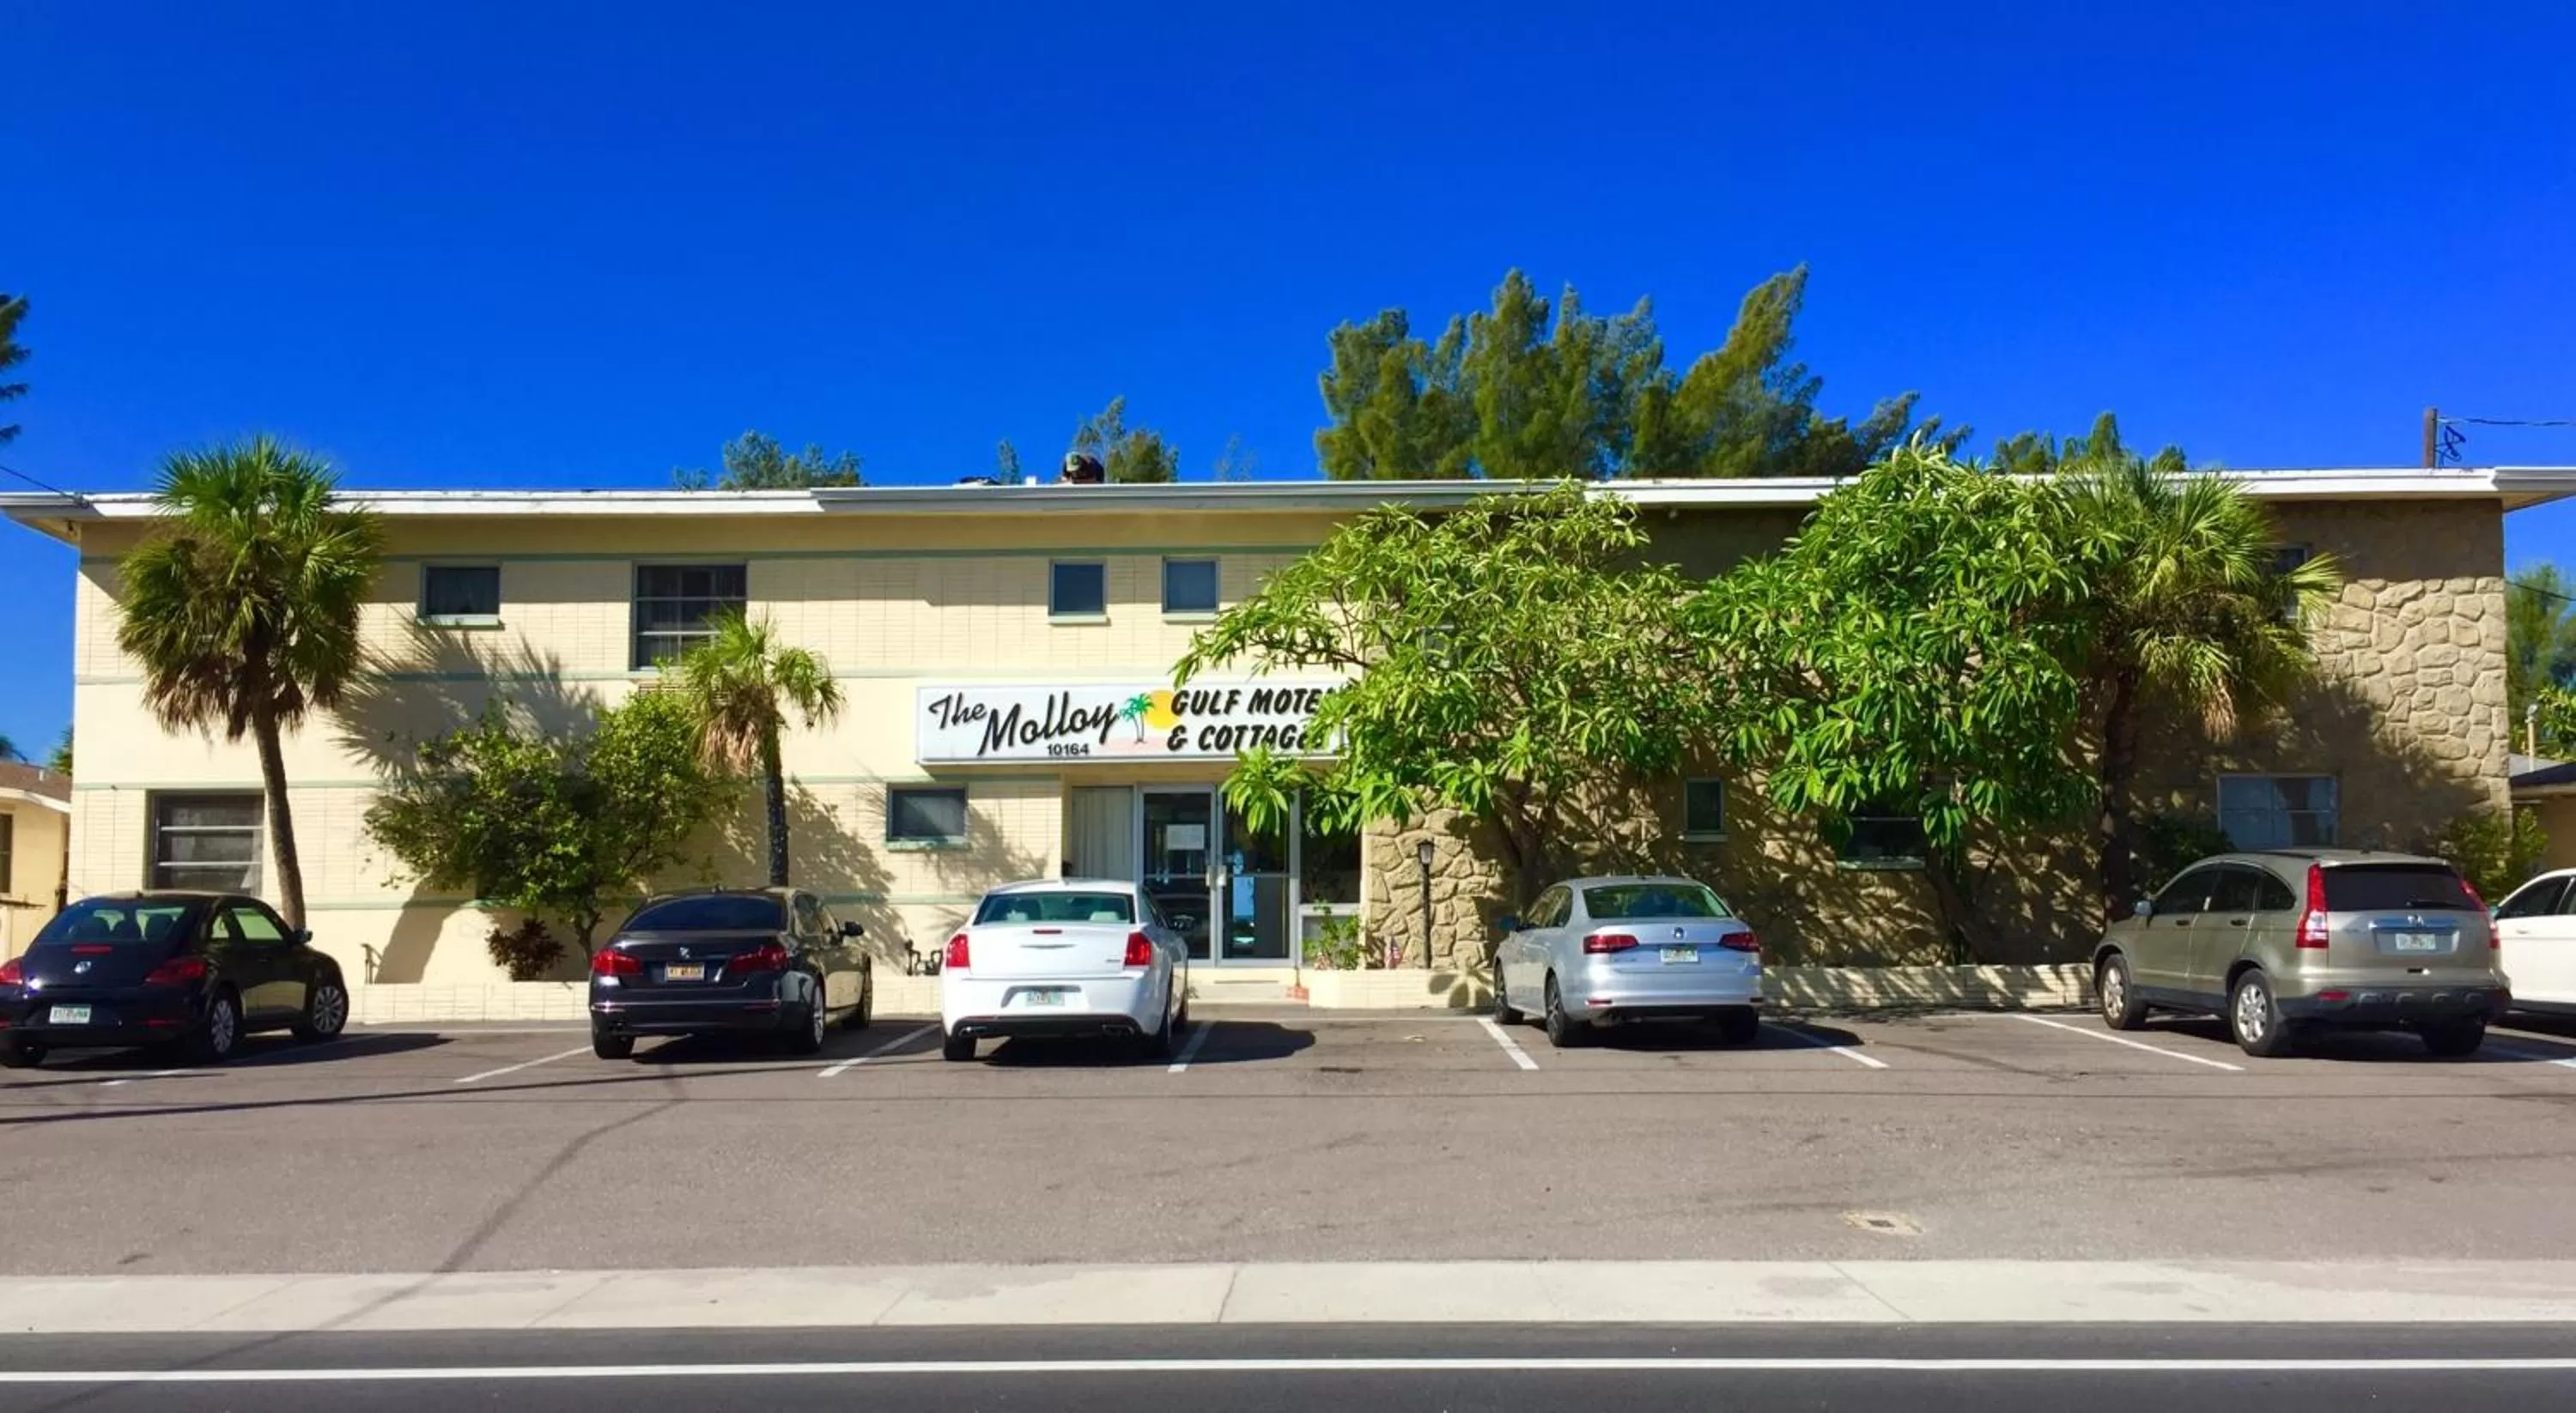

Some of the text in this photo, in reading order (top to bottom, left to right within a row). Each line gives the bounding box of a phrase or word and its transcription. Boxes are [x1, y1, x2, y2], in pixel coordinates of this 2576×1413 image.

[1170, 688, 1334, 716] GULF MOTE
[927, 690, 1121, 756] The Molloy
[1047, 743, 1090, 756] 10164
[1166, 724, 1189, 752] &
